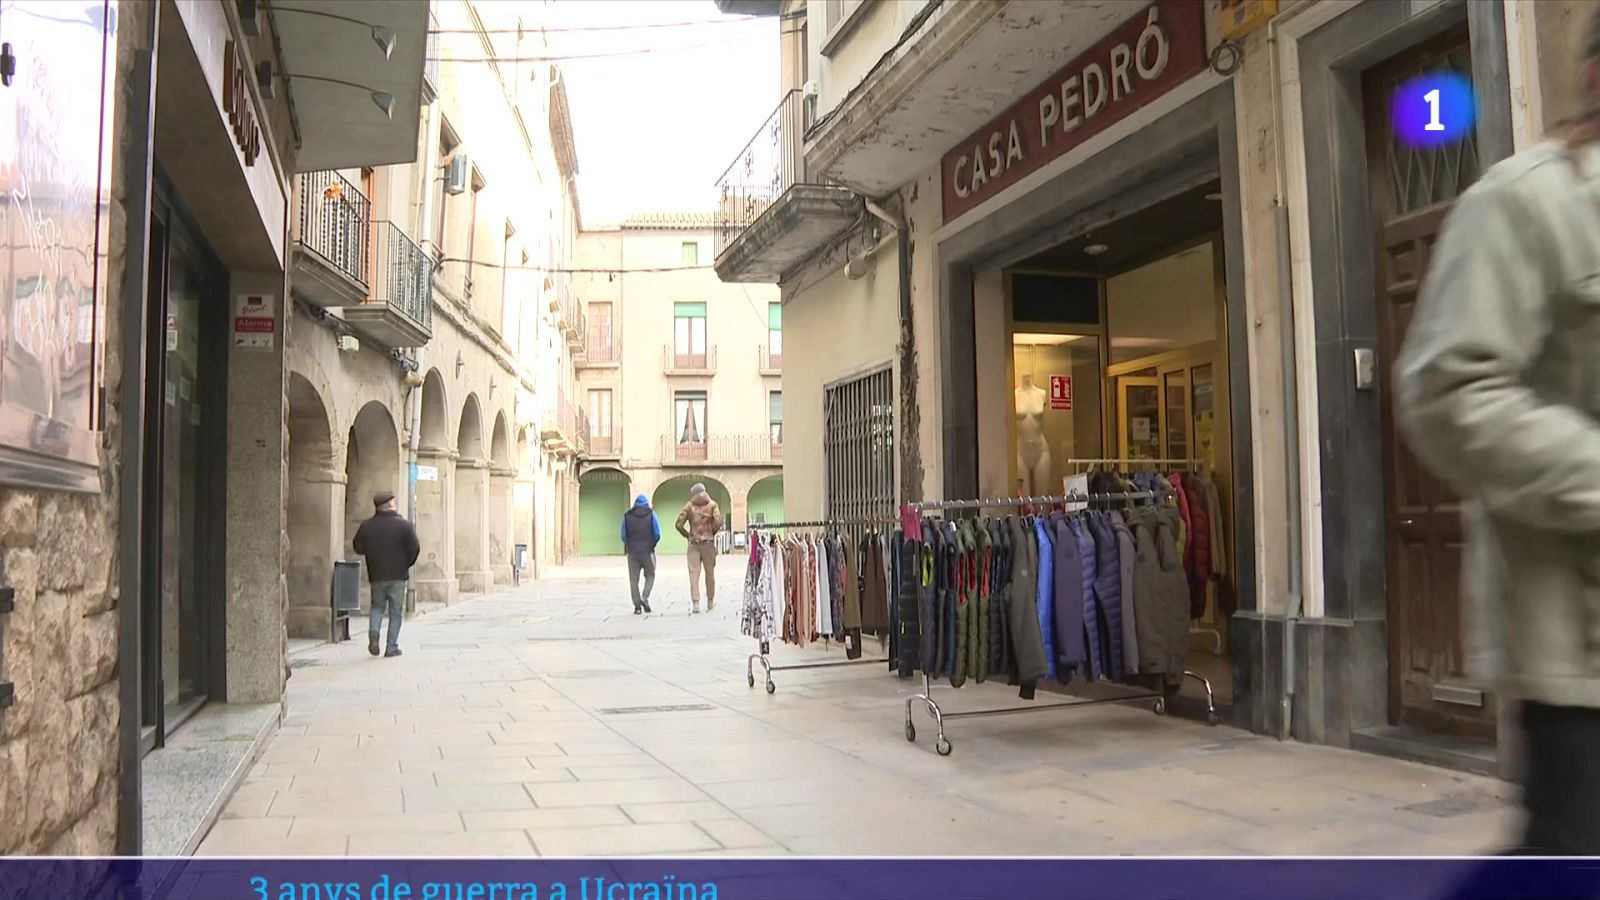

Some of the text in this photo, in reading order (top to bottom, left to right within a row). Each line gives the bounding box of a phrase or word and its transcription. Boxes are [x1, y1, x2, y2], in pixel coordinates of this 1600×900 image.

[953, 6, 1169, 198] CASA PEDRÓ
[238, 319, 273, 329] Alarma
